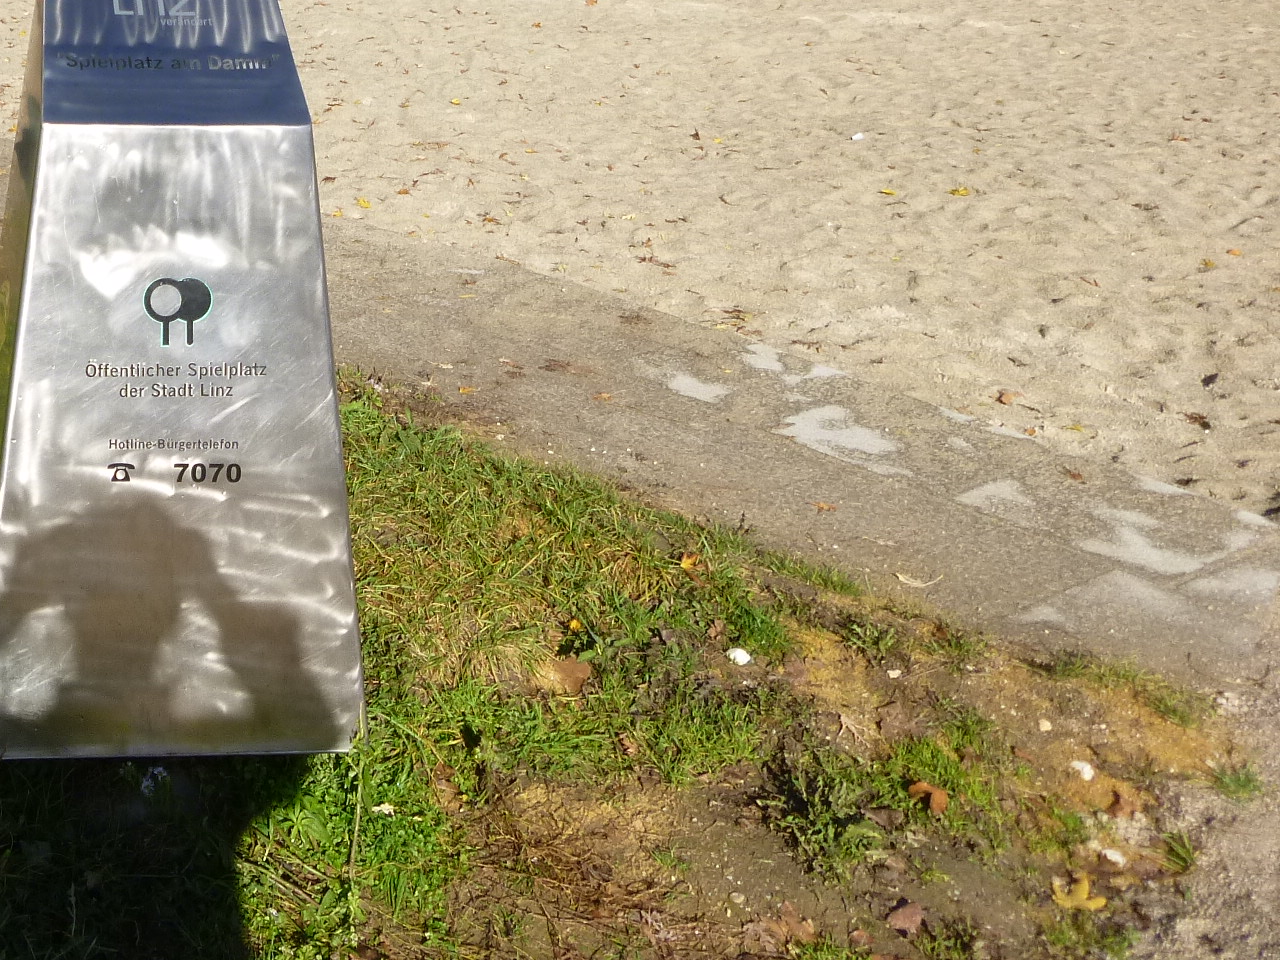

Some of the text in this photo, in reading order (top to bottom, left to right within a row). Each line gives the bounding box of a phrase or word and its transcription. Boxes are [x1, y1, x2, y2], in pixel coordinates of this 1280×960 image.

[171, 58, 201, 70] am
[85, 359, 267, 380] Öffentlicher Spielplatz
[119, 383, 233, 398] der Stadt Linz
[108, 438, 239, 453] Hotline-Bürgertelefon
[173, 463, 242, 483] 7070
